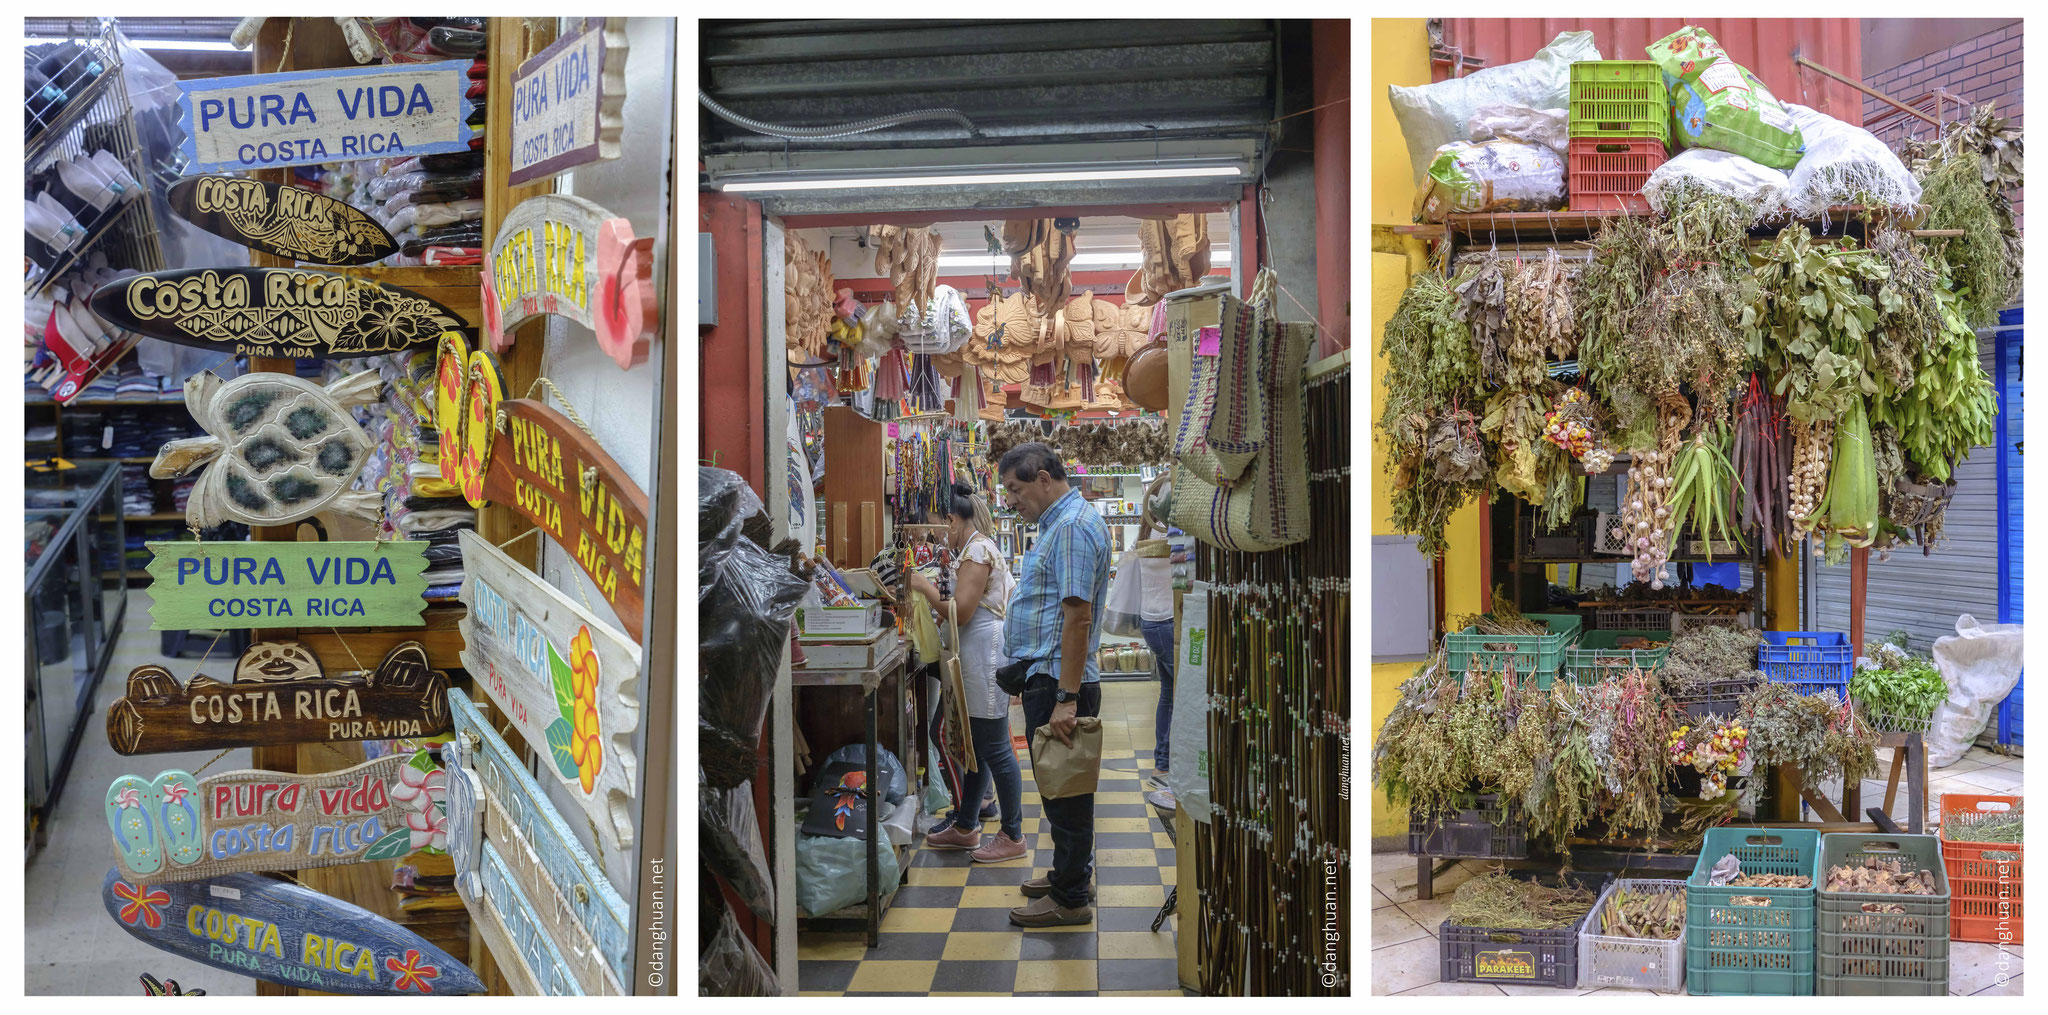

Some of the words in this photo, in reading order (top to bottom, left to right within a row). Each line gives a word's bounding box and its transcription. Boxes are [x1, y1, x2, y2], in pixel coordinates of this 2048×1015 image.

[201, 92, 317, 132] PURA
[337, 83, 434, 121] VIDA
[515, 71, 548, 127] PURA
[555, 43, 590, 105] VIDA
[238, 138, 328, 165] COSTA
[342, 132, 404, 156] RICA
[522, 131, 549, 166] COSTA
[552, 120, 574, 156] RICA
[197, 177, 267, 213] COSTA
[278, 186, 326, 222] RICA
[275, 247, 292, 259] PURA
[296, 253, 309, 262] VIDA
[495, 226, 538, 312] COSTA
[544, 220, 587, 310] RICA
[128, 271, 248, 318] Costa
[266, 271, 345, 309] Rica
[522, 296, 539, 317] PURA
[543, 294, 559, 315] VIDA
[236, 343, 274, 358] PURA
[283, 347, 314, 359] VIDA
[511, 415, 566, 494] PURA
[577, 458, 643, 587] VIDA
[515, 477, 564, 538] COSTA
[577, 528, 618, 604] RICA
[177, 557, 286, 586] PURA
[306, 557, 396, 585] VIDA
[208, 598, 293, 617] COSTA
[306, 598, 365, 617] RICA
[475, 578, 510, 647] COSTA
[515, 612, 547, 687] RICA
[190, 693, 282, 724] COSTA
[295, 688, 362, 719] RICA
[489, 663, 507, 702] PURA
[511, 694, 528, 728] VIDA
[329, 721, 377, 740] PURA
[380, 719, 422, 737] VIDA
[215, 783, 300, 819] pura
[318, 775, 390, 815] vida
[210, 824, 294, 860] costa
[309, 816, 385, 855] rica
[486, 760, 542, 895] PURA
[186, 905, 283, 957] COSTA
[303, 933, 377, 981] RICA
[486, 861, 543, 980] COSTA
[210, 943, 262, 972] PURA
[279, 964, 323, 985] VIDA
[1479, 965, 1531, 974] PARAKEET
